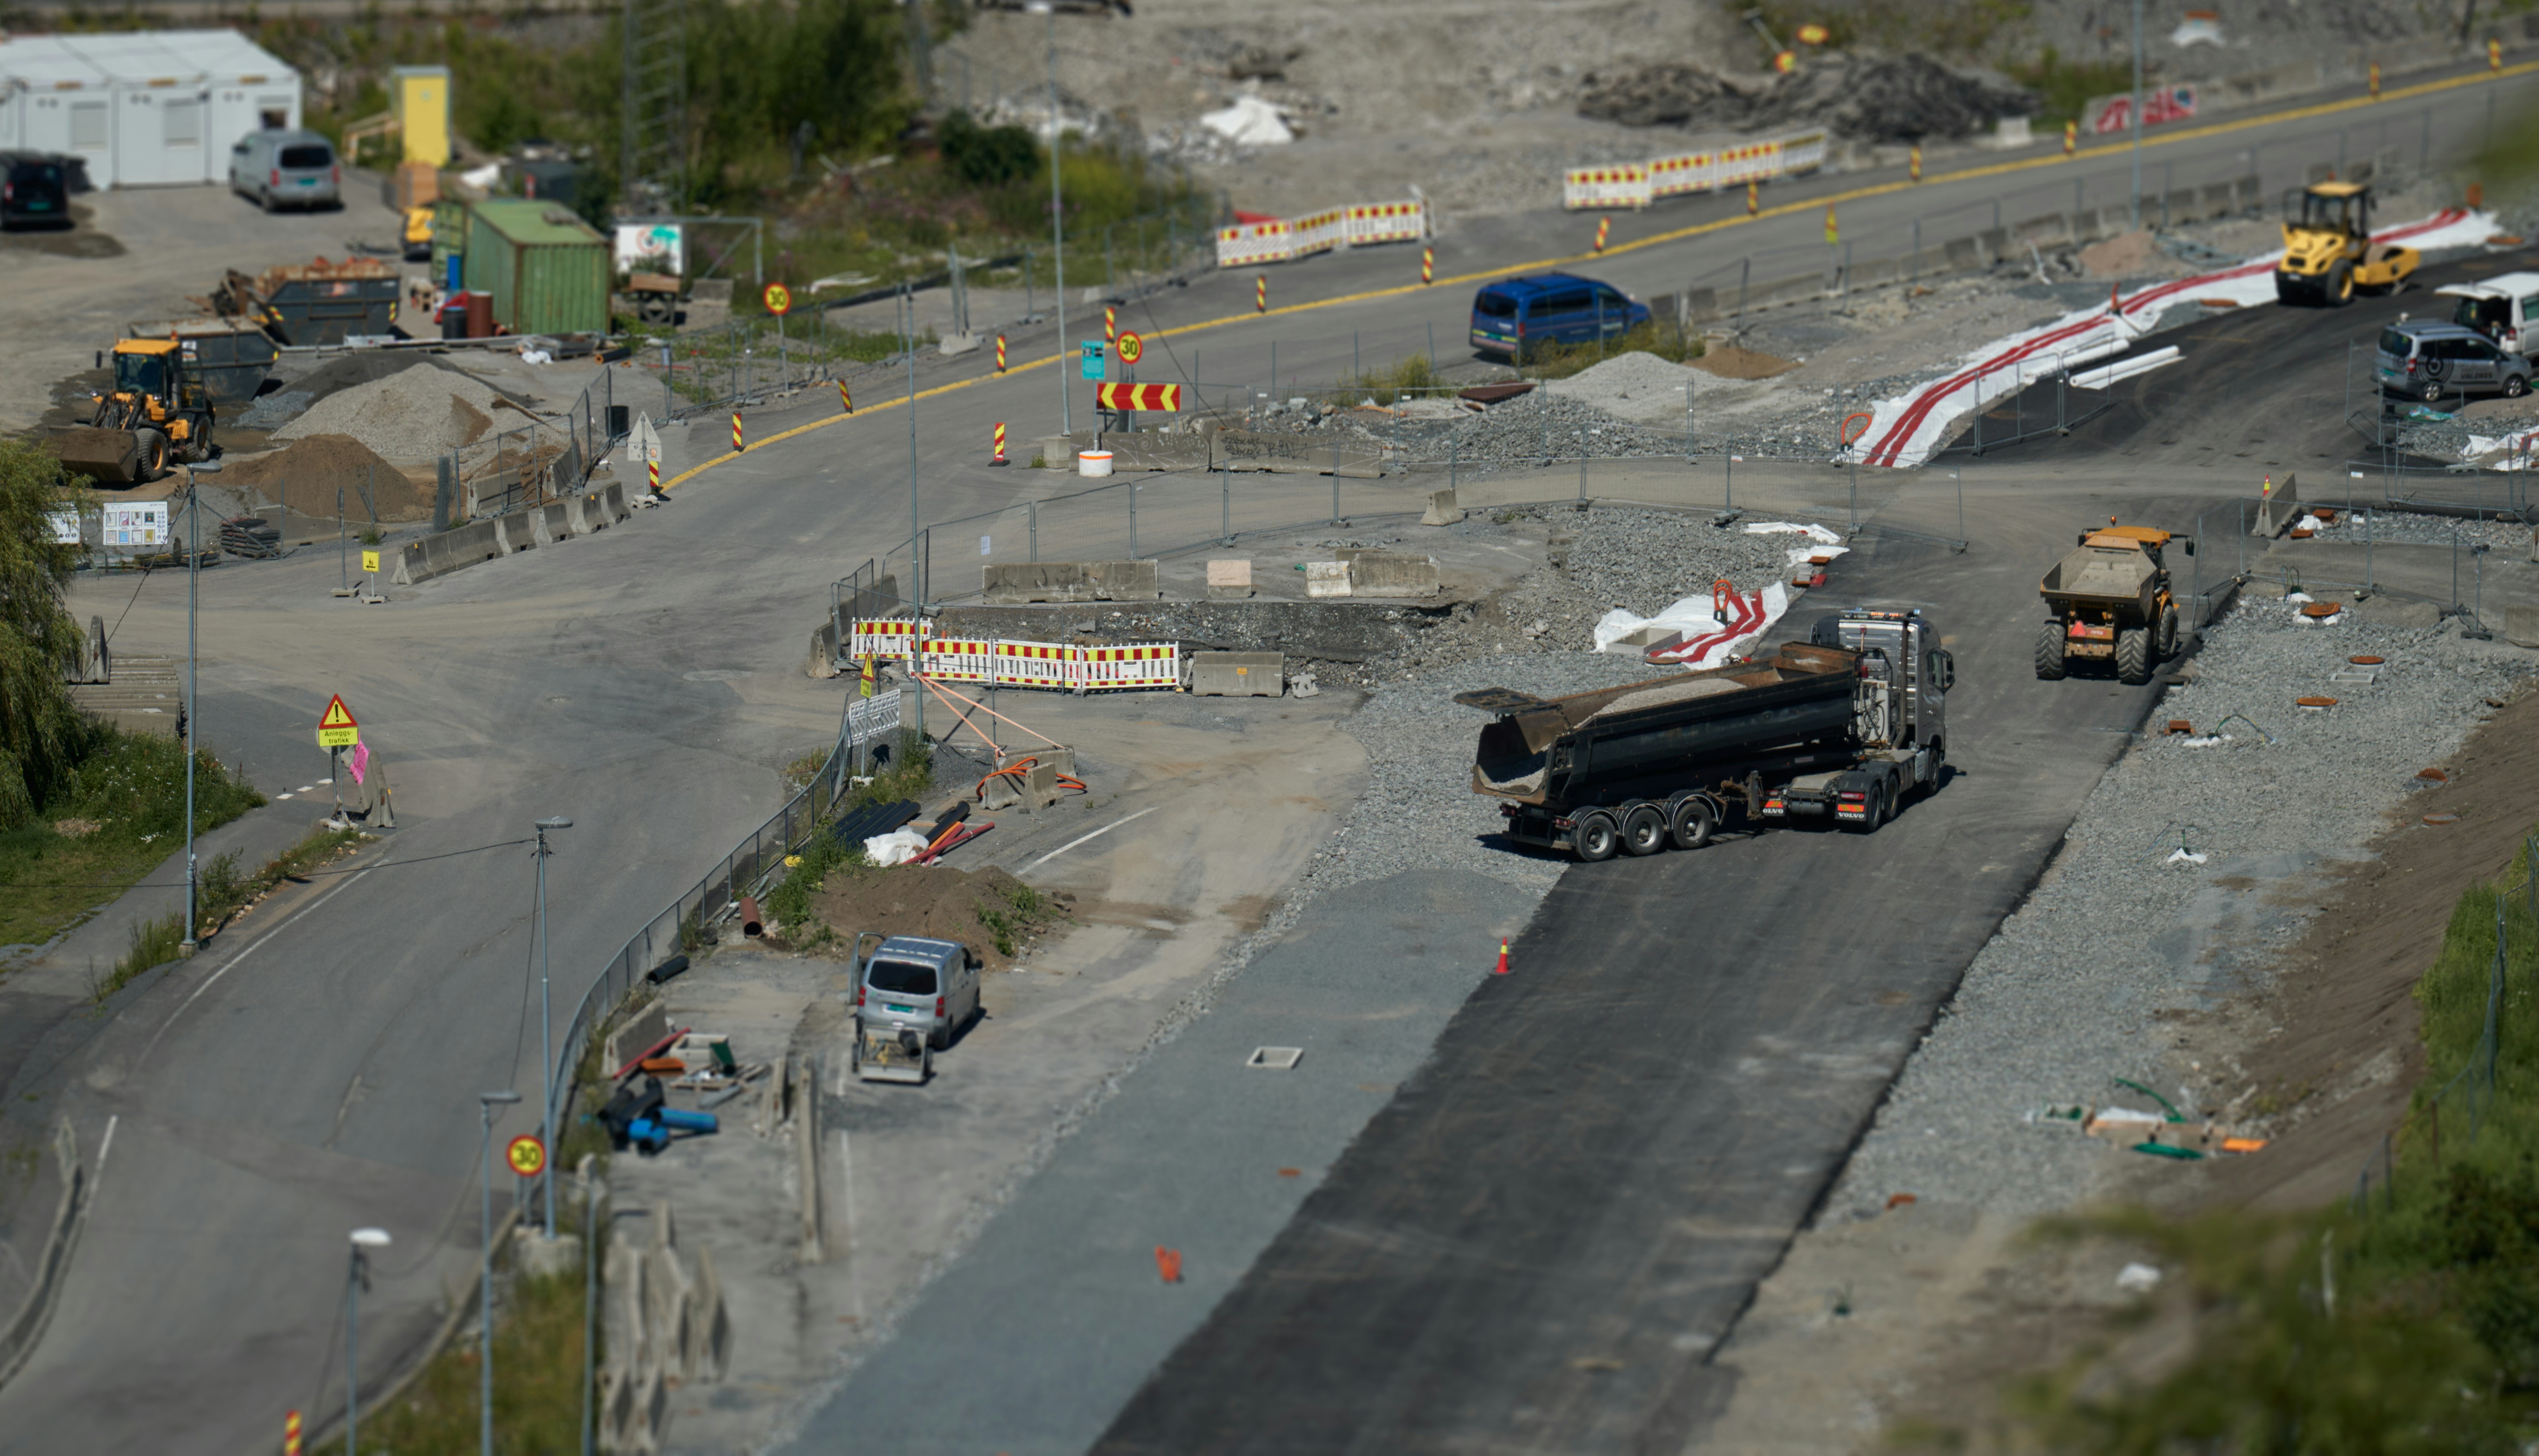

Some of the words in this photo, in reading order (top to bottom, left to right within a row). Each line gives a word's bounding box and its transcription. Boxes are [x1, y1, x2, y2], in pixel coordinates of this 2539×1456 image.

[770, 290, 785, 307] 30
[1121, 339, 1138, 356] 30
[514, 1144, 541, 1166] 30
